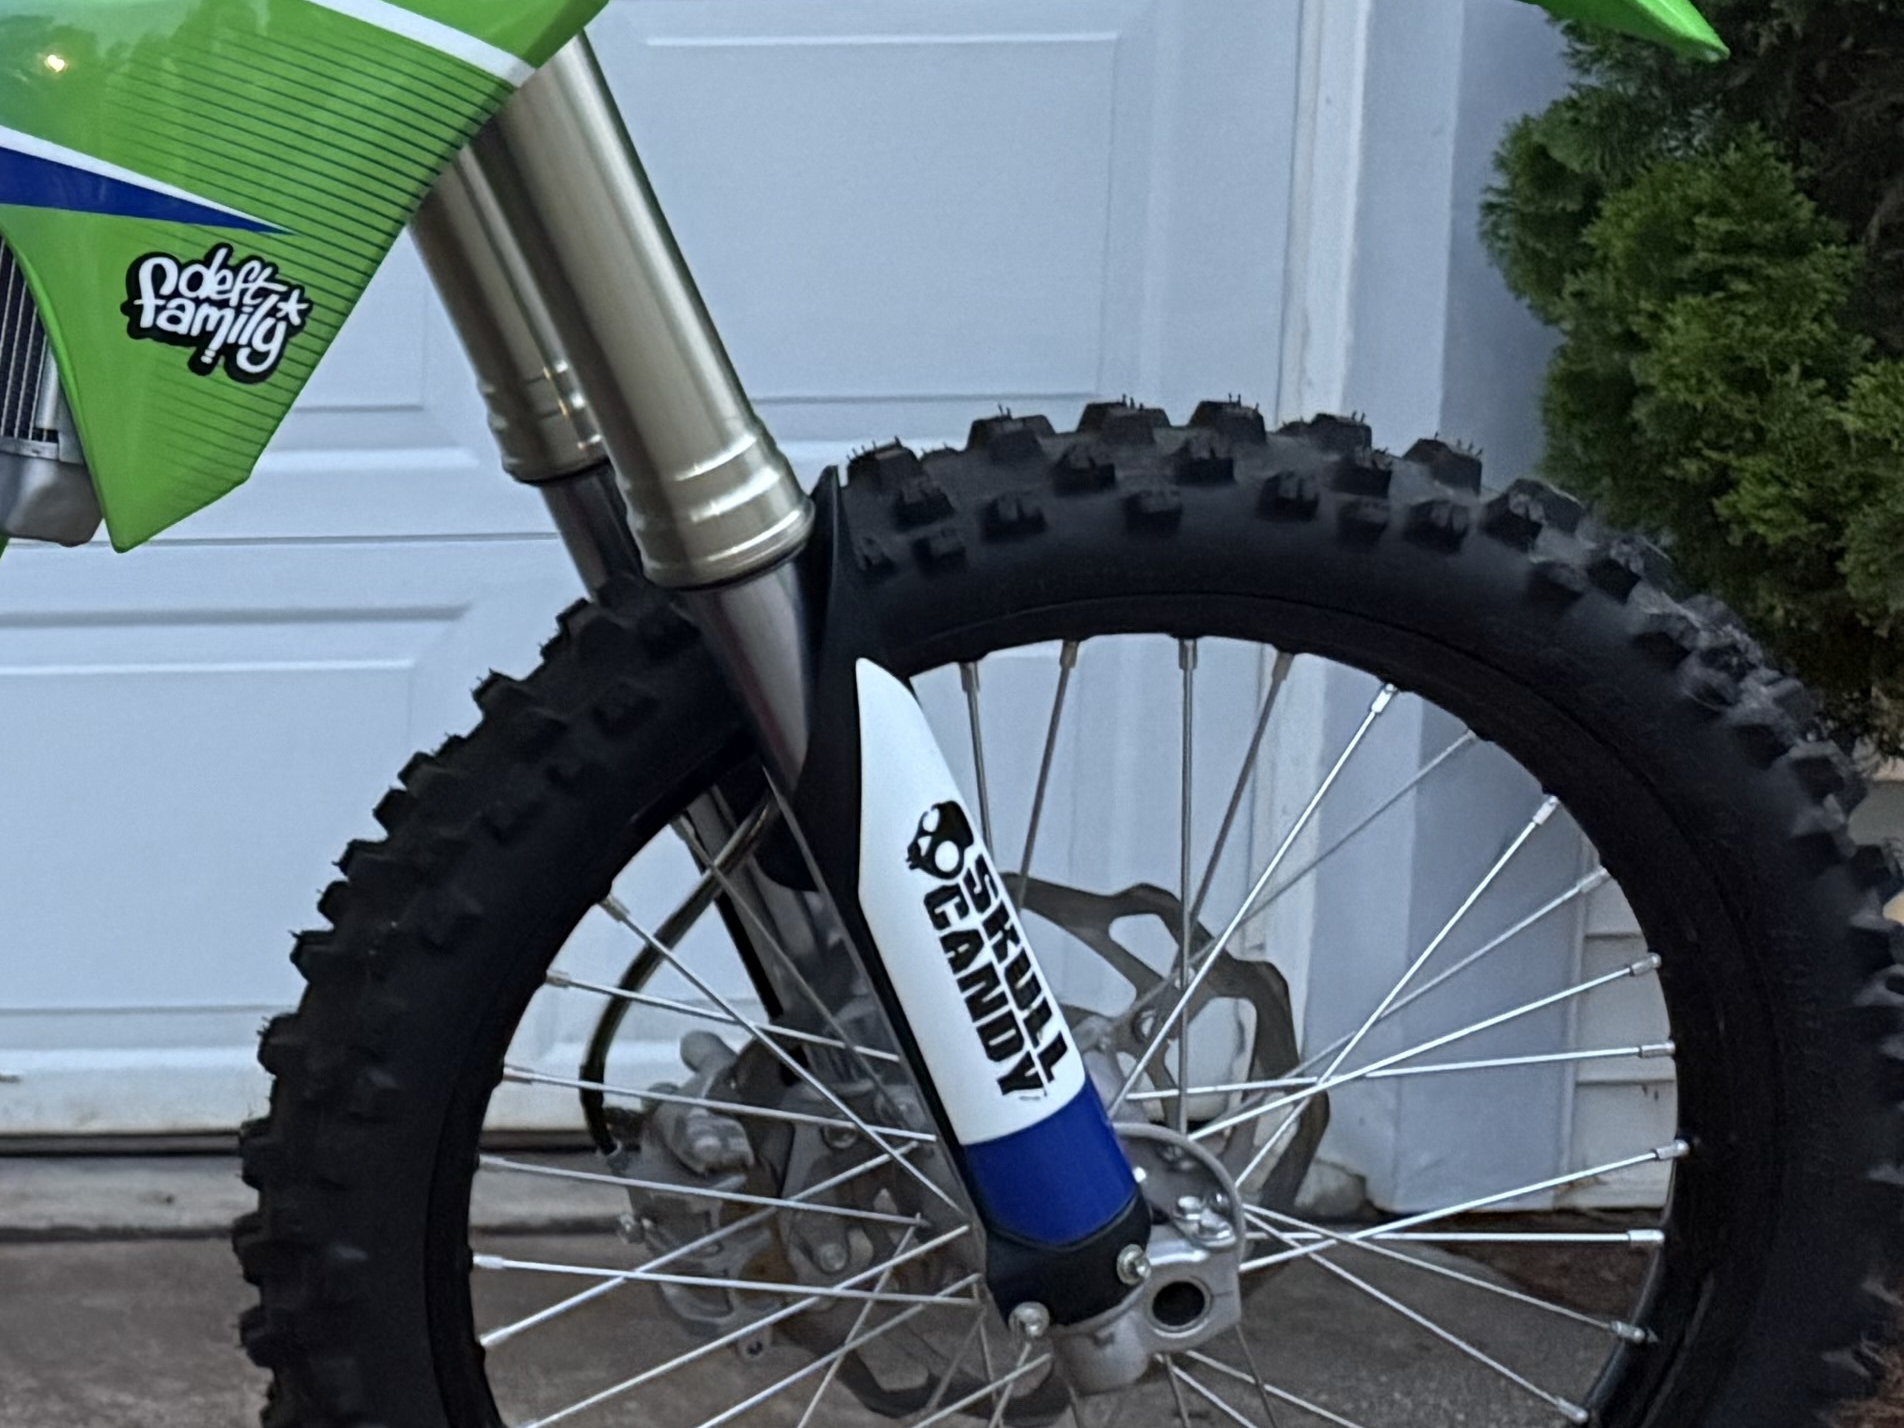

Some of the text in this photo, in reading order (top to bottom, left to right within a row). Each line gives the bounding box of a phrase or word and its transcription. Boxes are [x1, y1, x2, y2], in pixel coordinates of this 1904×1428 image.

[177, 246, 289, 307] deft
[923, 882, 1046, 1096] CANDY
[962, 852, 1069, 1084] SKULL
